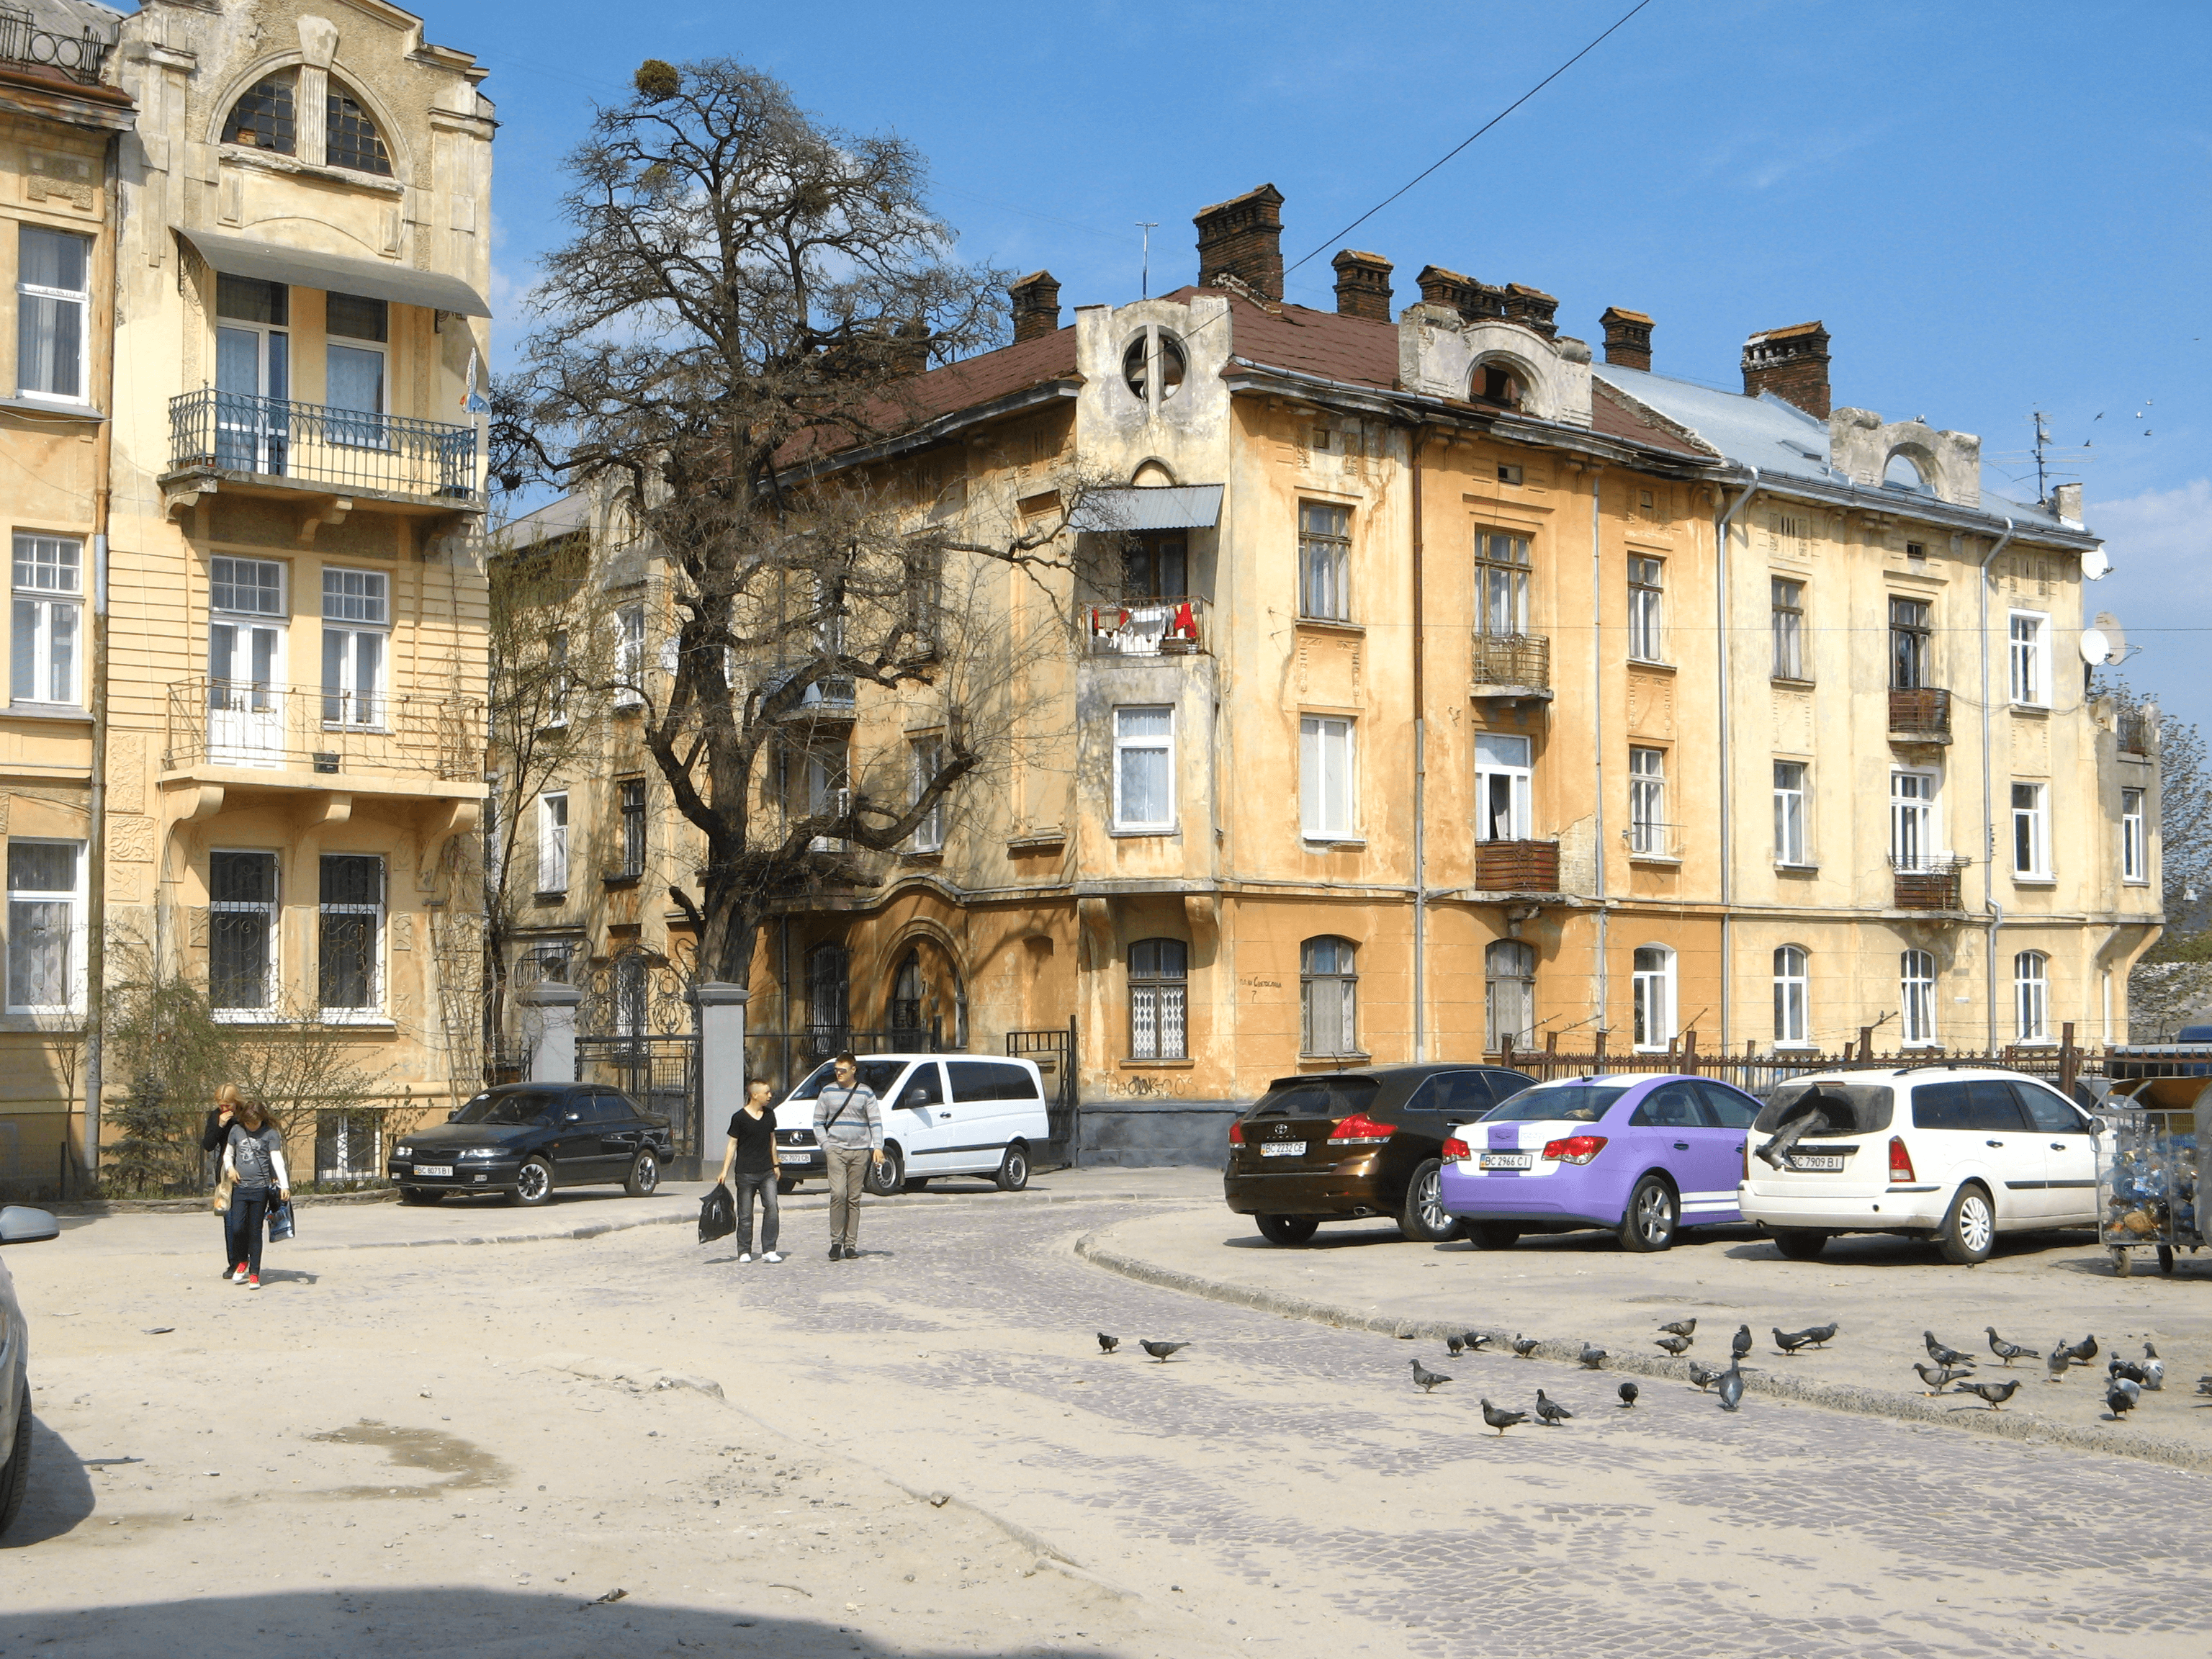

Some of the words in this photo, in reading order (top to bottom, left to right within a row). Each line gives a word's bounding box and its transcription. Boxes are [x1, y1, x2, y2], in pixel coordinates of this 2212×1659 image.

[1251, 990, 1256, 1002] 7
[1266, 1143, 1275, 1153] BC
[1277, 1143, 1292, 1153] 2232
[1294, 1143, 1304, 1152] CE
[1485, 1156, 1496, 1166] BC
[1498, 1156, 1515, 1166] 2966
[1517, 1156, 1527, 1166] CI
[1805, 1156, 1825, 1167] 7909
[1827, 1157, 1838, 1168] BI
